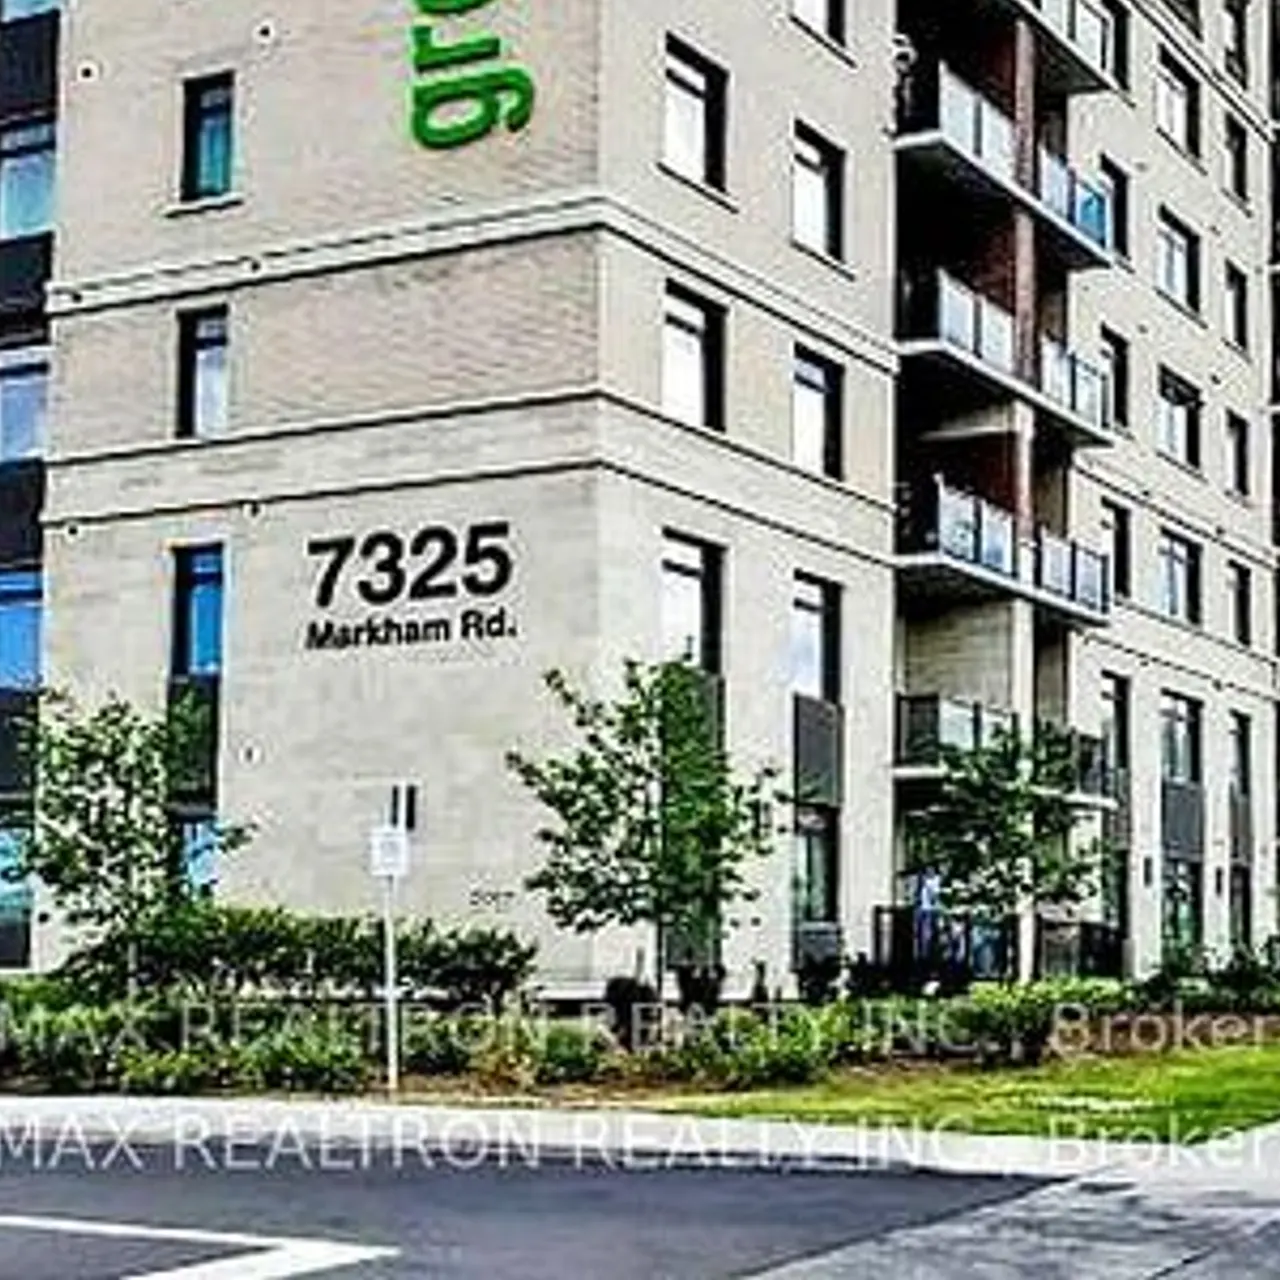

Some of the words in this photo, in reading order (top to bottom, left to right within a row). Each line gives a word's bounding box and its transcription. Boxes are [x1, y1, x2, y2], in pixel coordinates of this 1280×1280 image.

[307, 521, 513, 607] 7325
[305, 617, 451, 650] Markham
[461, 607, 517, 641] Rd.
